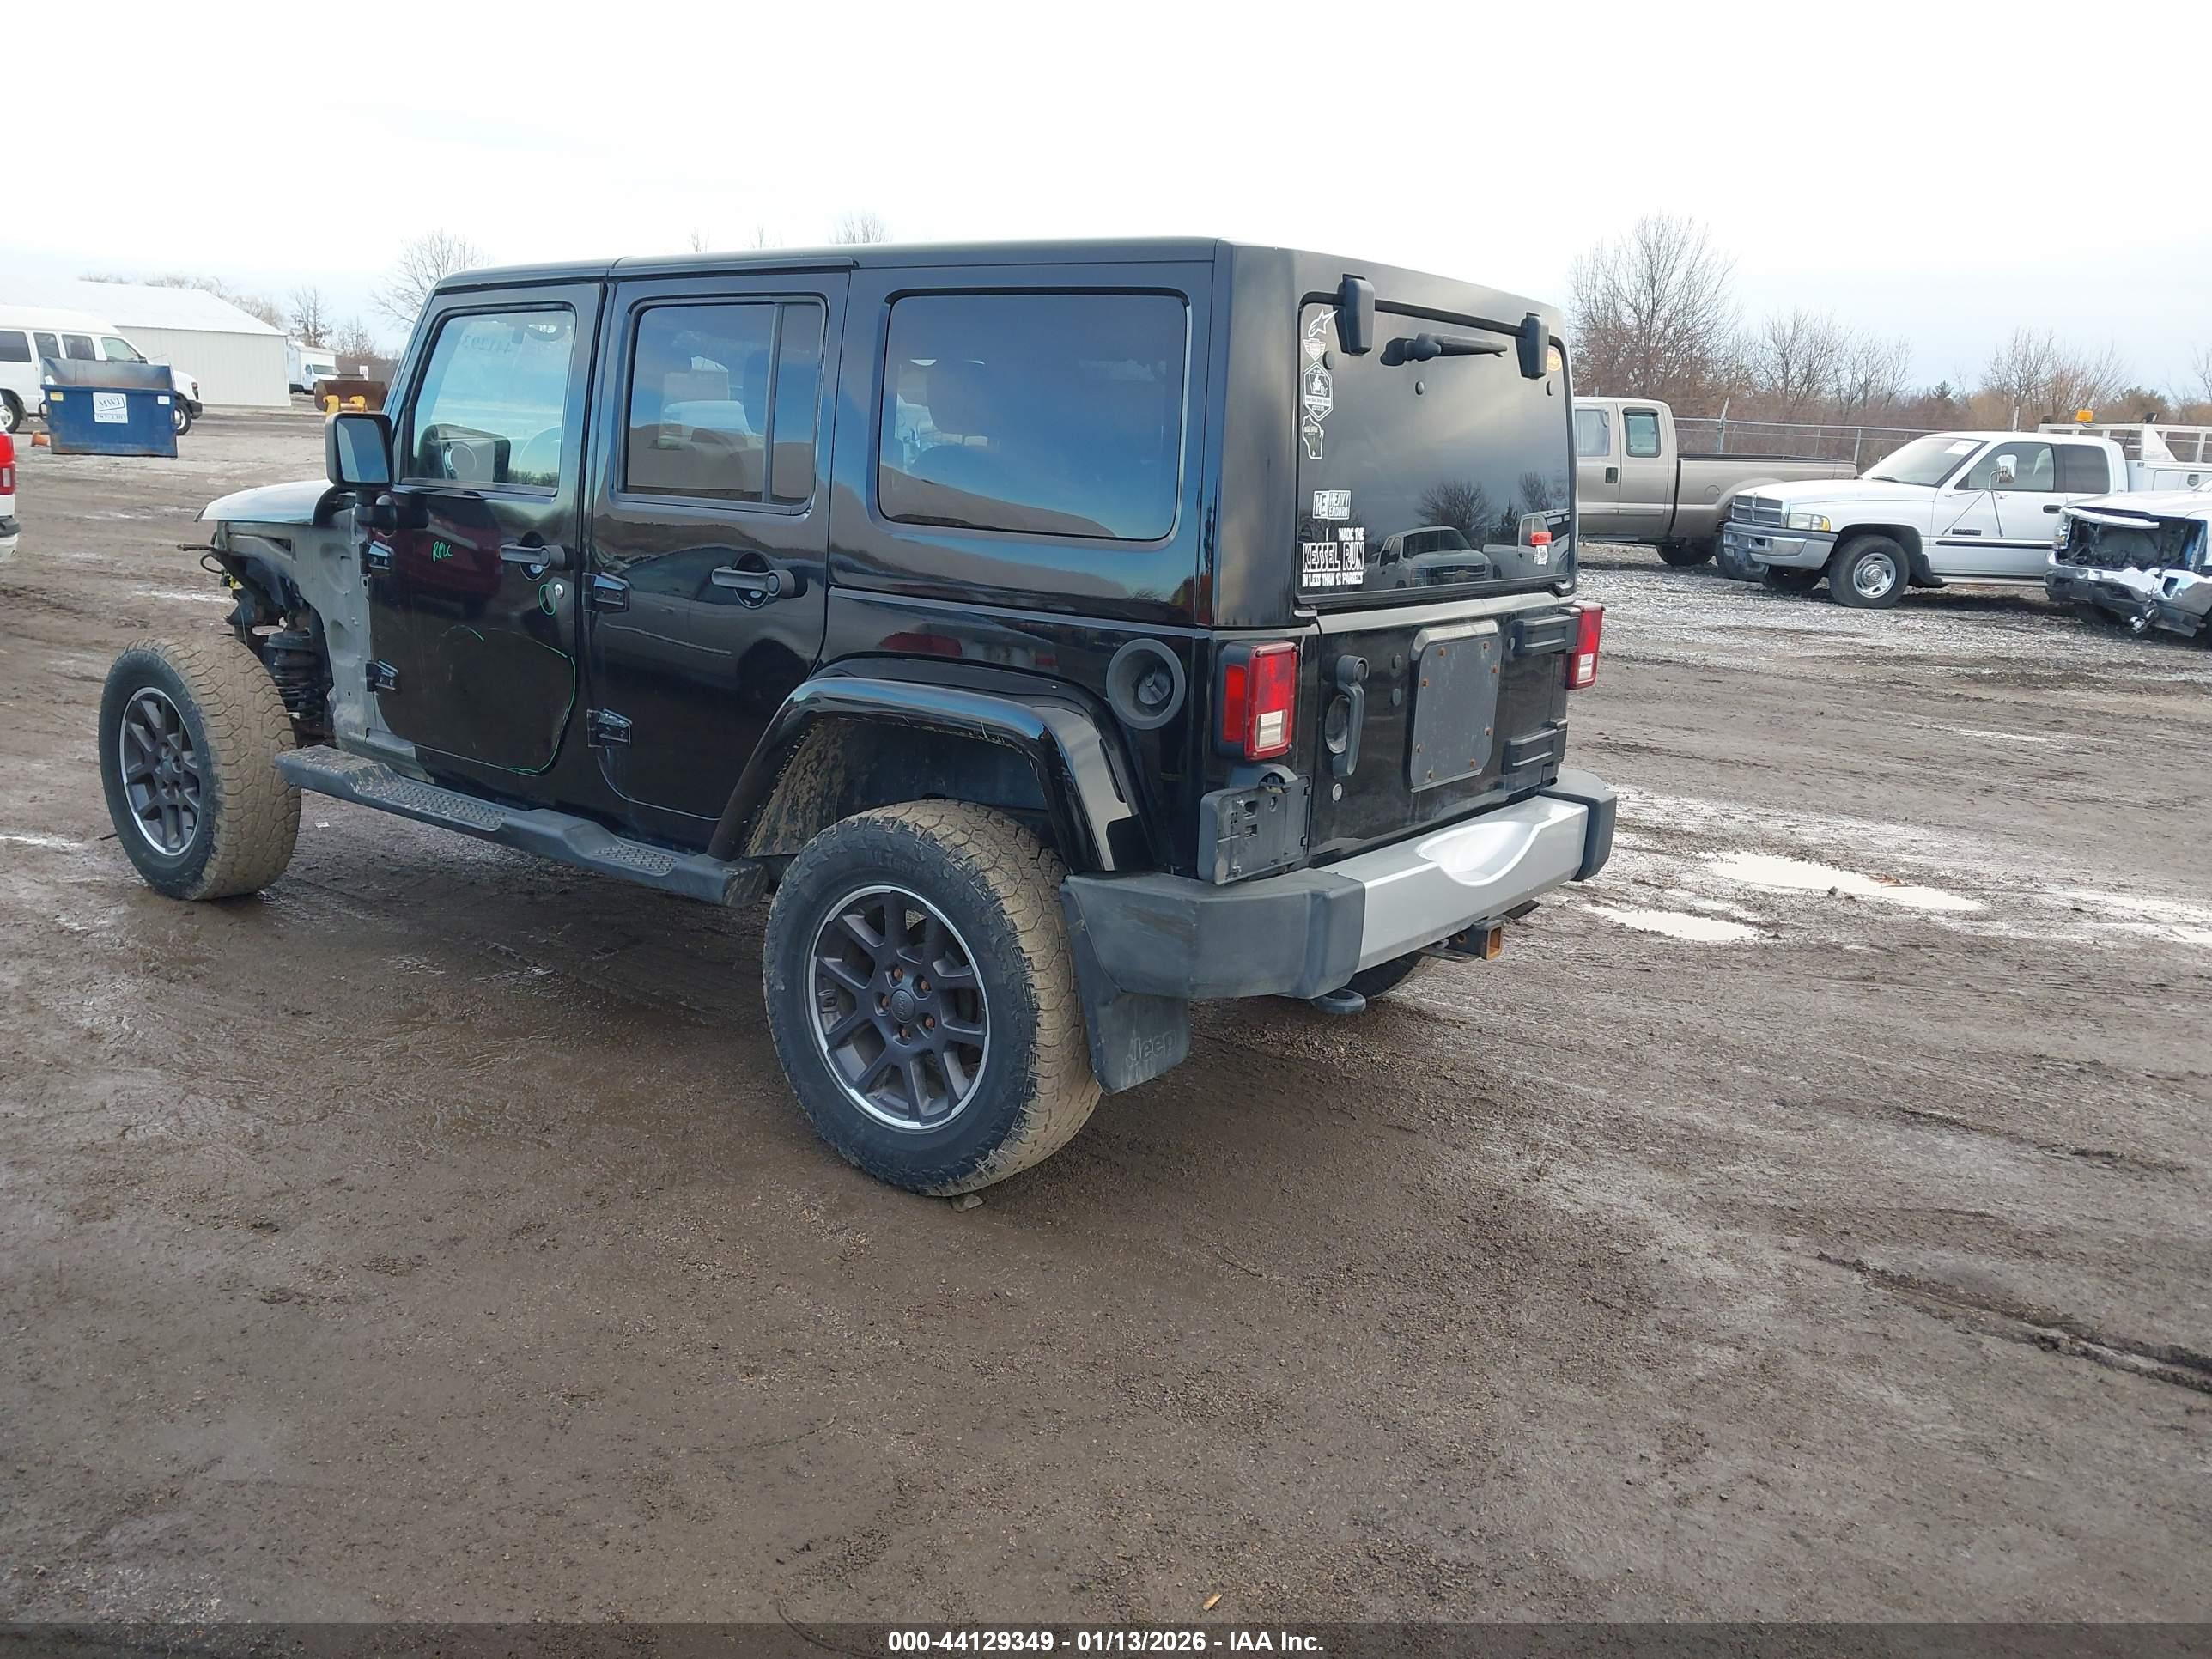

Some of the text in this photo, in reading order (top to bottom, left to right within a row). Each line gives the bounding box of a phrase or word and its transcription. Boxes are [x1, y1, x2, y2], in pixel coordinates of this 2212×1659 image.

[1330, 492, 1349, 506] HEAVY
[1303, 542, 1364, 573] KESSEL RUN
[1309, 573, 1321, 587] LESS
[1322, 573, 1335, 586] THAN
